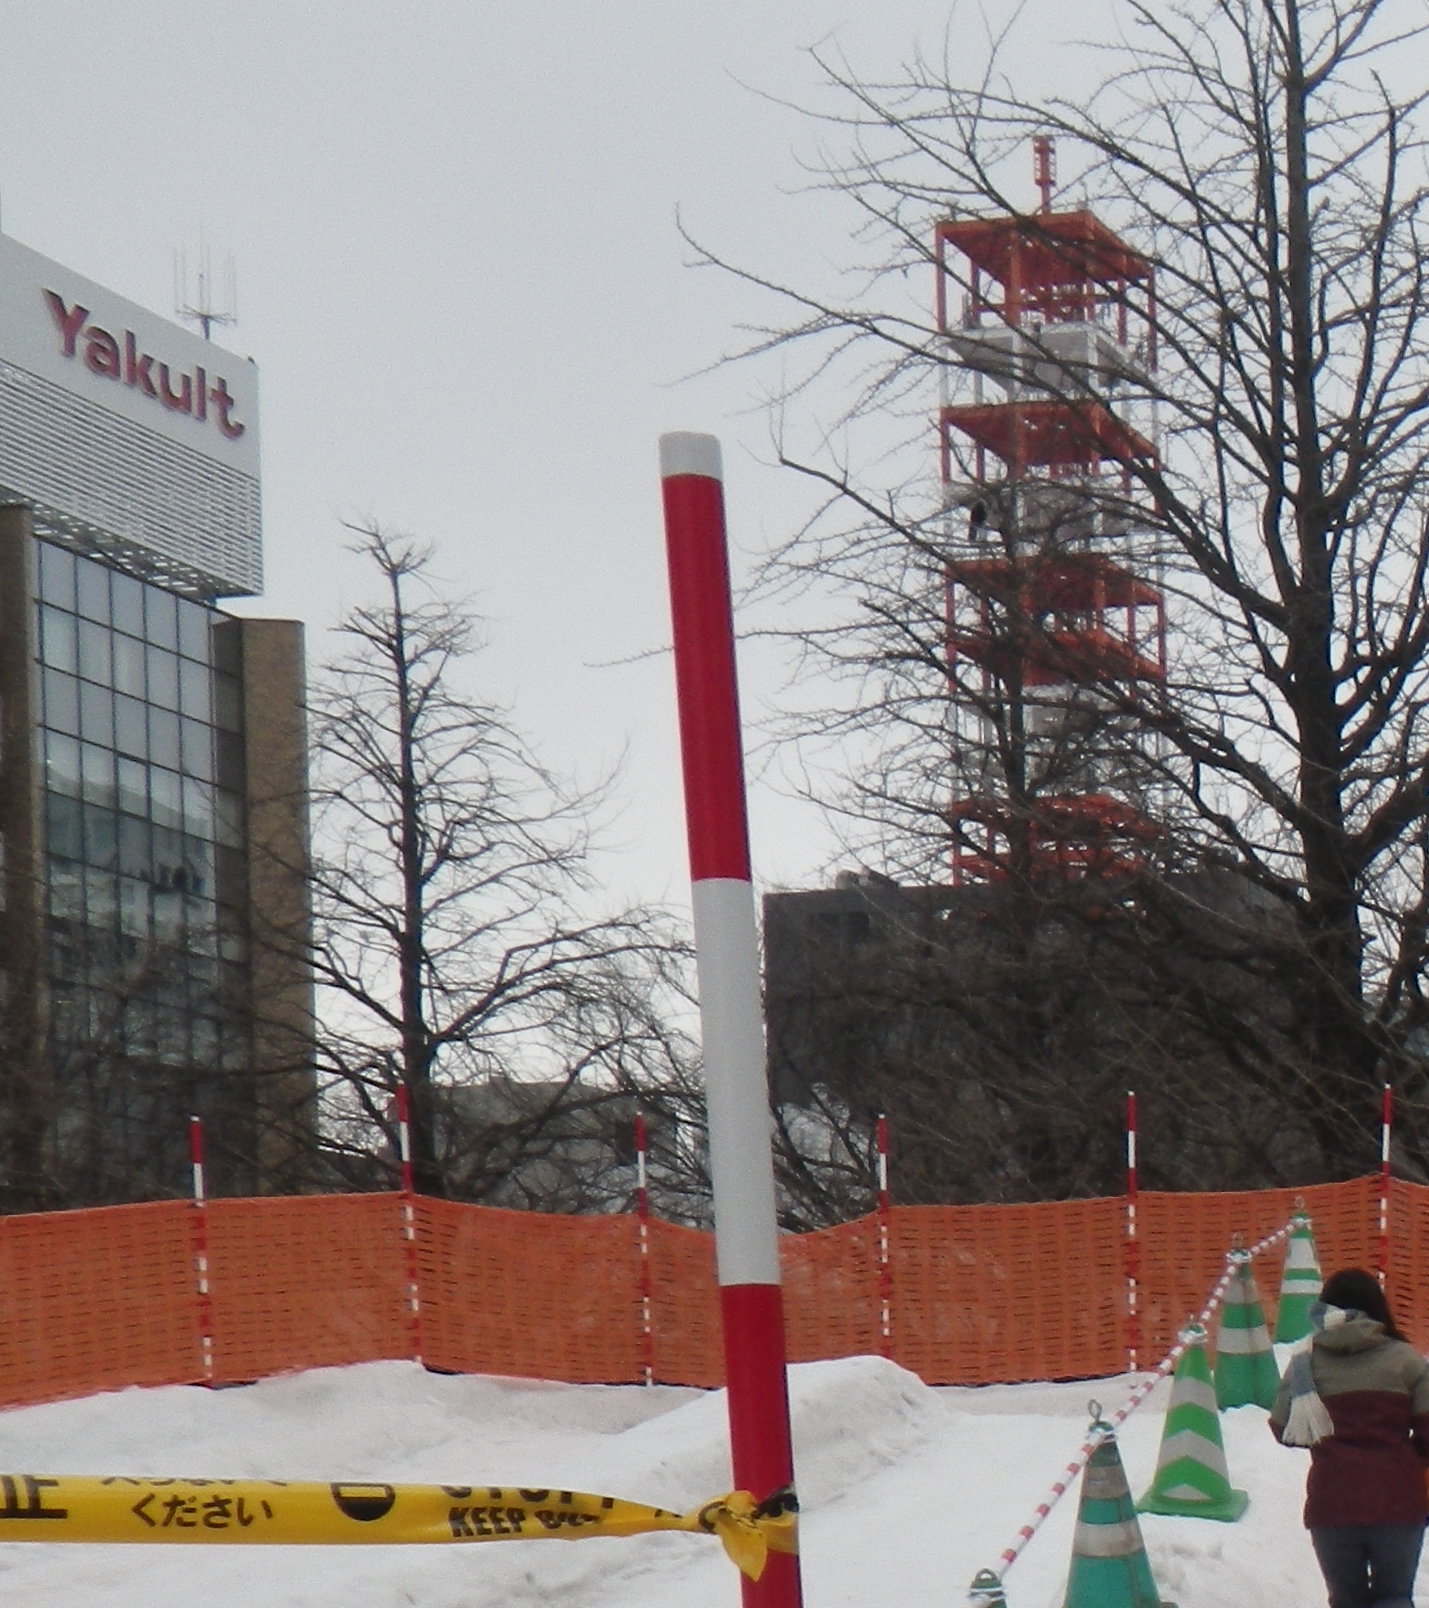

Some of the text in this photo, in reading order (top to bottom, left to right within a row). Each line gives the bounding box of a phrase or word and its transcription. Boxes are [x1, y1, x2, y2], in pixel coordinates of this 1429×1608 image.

[42, 288, 245, 439] Yakult
[131, 1493, 273, 1529] ください
[447, 1506, 527, 1538] KEEP
